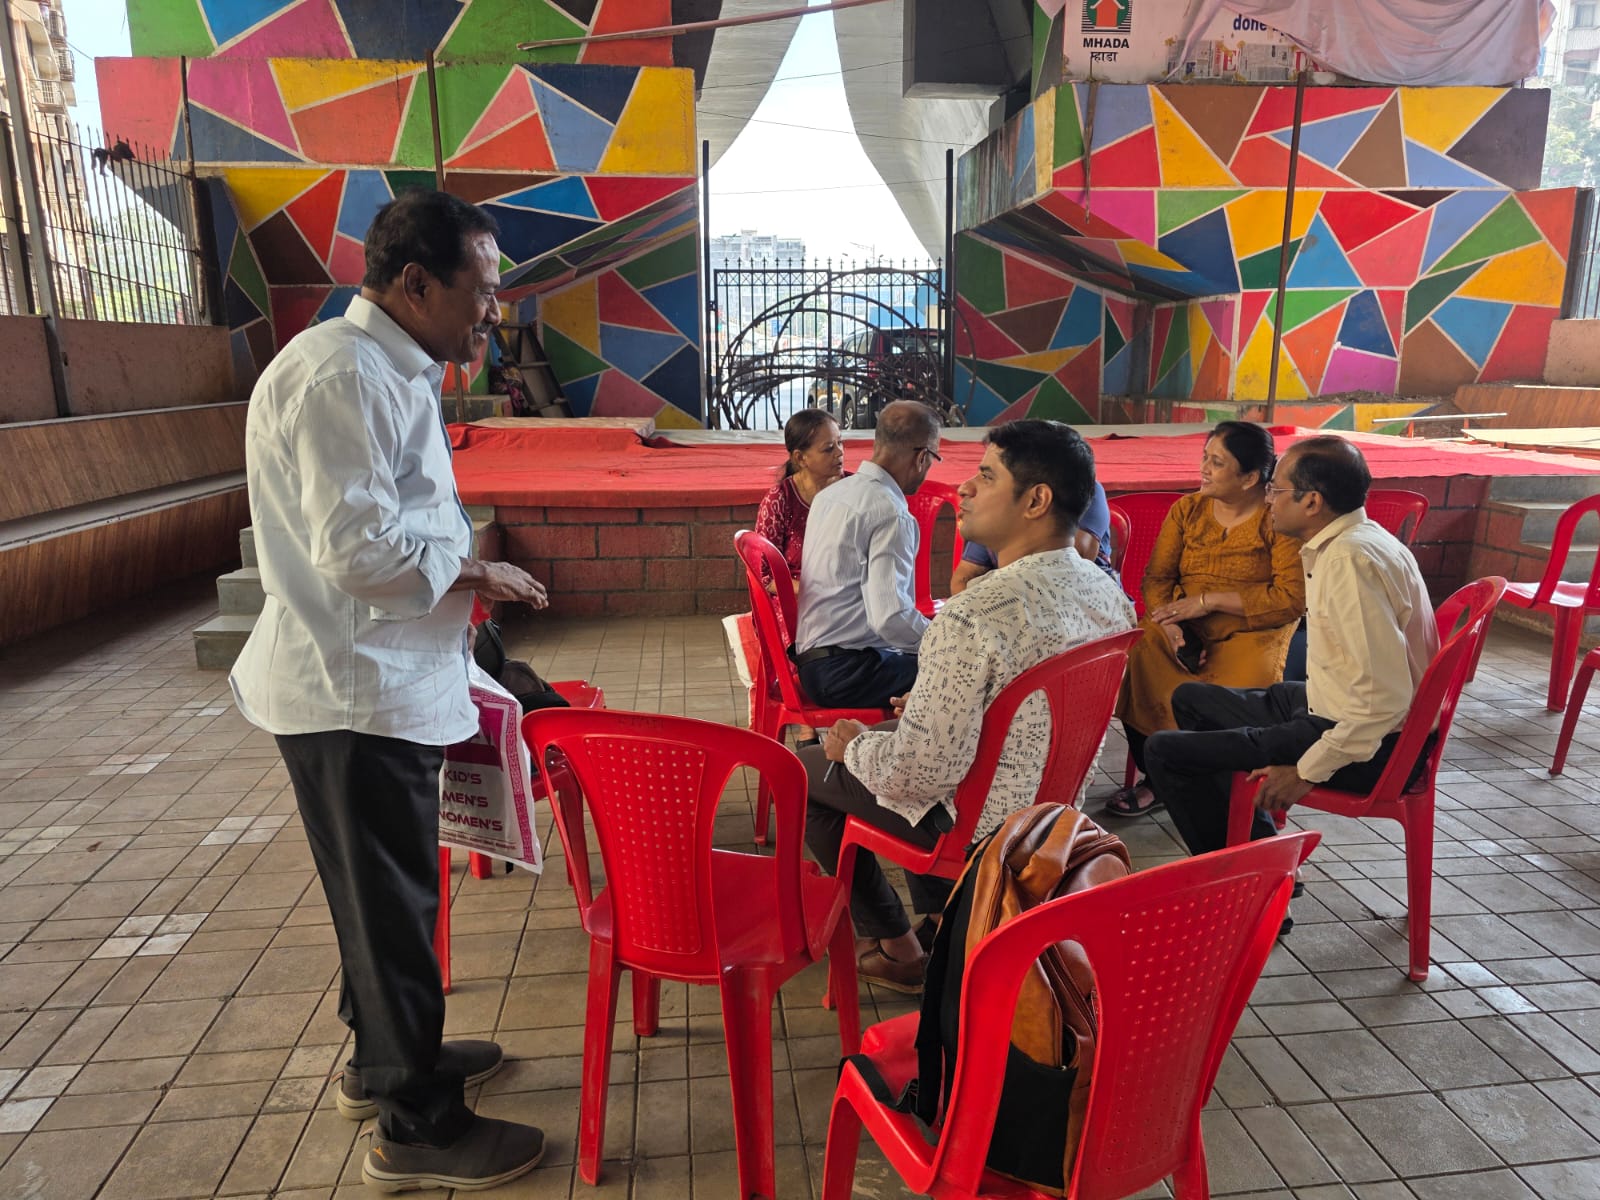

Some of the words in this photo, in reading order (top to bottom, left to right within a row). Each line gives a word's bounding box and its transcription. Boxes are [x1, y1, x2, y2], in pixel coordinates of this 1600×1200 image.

[1083, 37, 1130, 49] MHADA
[1090, 51, 1119, 63] म्हाडा
[443, 769, 482, 785] KID'S
[442, 790, 489, 808] MEN'S
